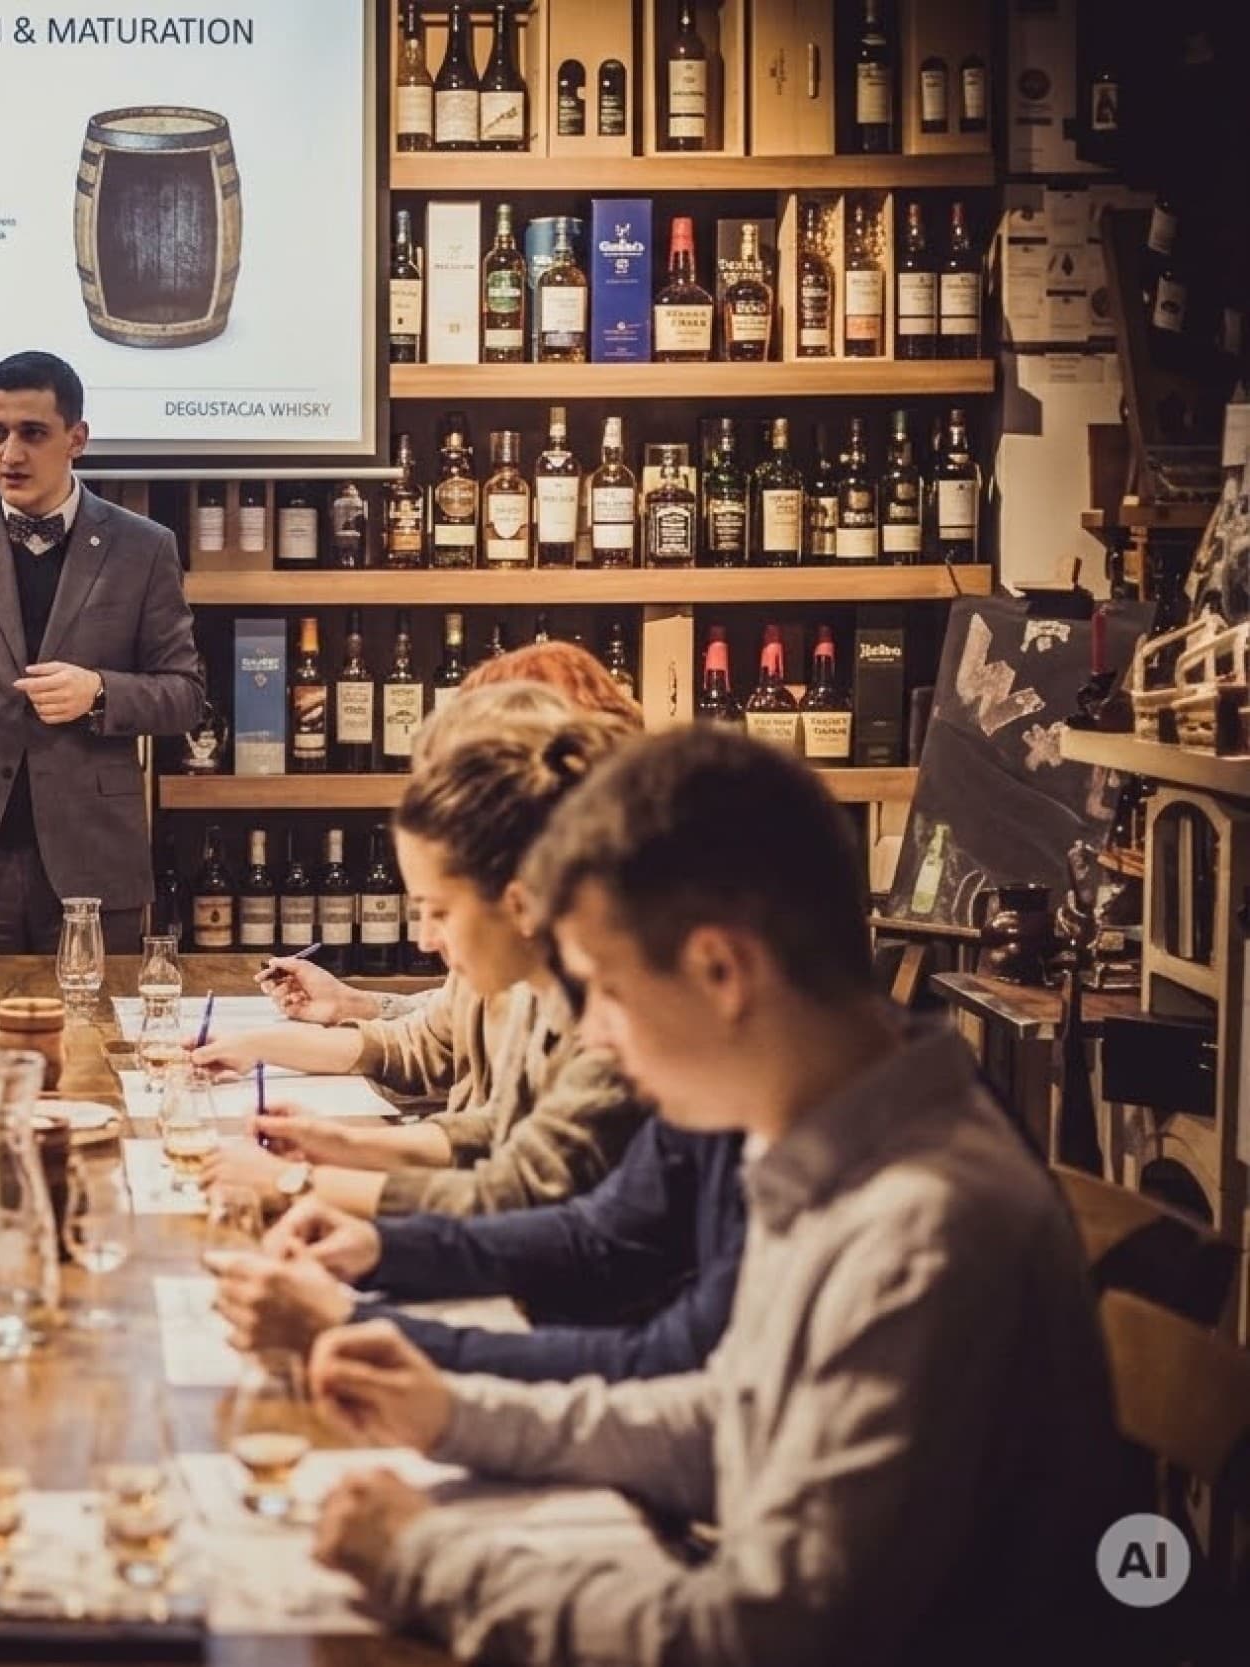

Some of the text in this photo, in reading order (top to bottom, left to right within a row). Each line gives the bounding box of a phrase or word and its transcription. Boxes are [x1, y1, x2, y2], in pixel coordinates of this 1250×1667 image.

[13, 16, 37, 45] &
[48, 17, 254, 45] MATURATION
[164, 400, 332, 418] DEGUSTACJA WHISKY
